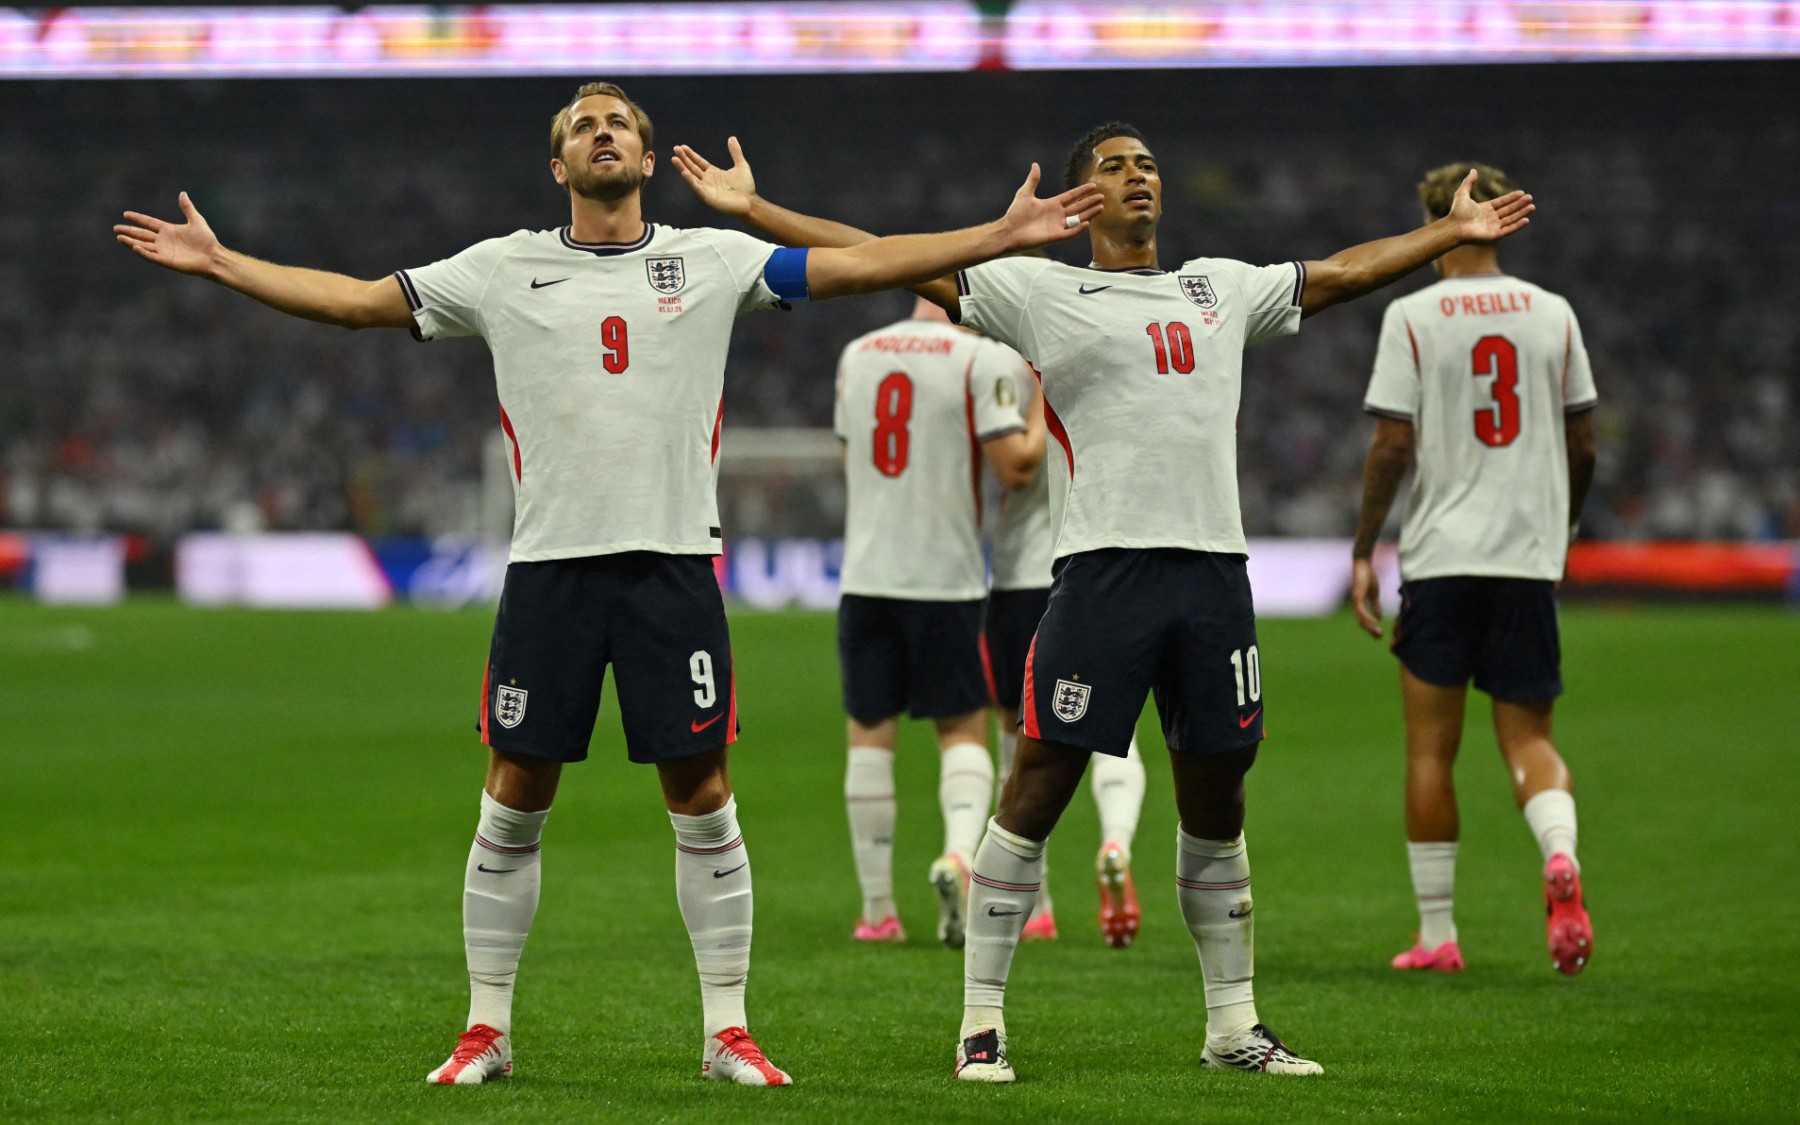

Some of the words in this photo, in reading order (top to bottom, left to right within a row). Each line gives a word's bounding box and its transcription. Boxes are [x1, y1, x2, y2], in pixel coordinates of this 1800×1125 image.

[658, 296, 682, 304] MEXICO
[1440, 293, 1532, 317] O'REILLY
[600, 315, 629, 374] 9
[1145, 321, 1195, 375] 10
[1471, 335, 1520, 448] 3
[872, 371, 914, 478] 8
[689, 649, 717, 709] 9
[1230, 644, 1261, 707] 10
